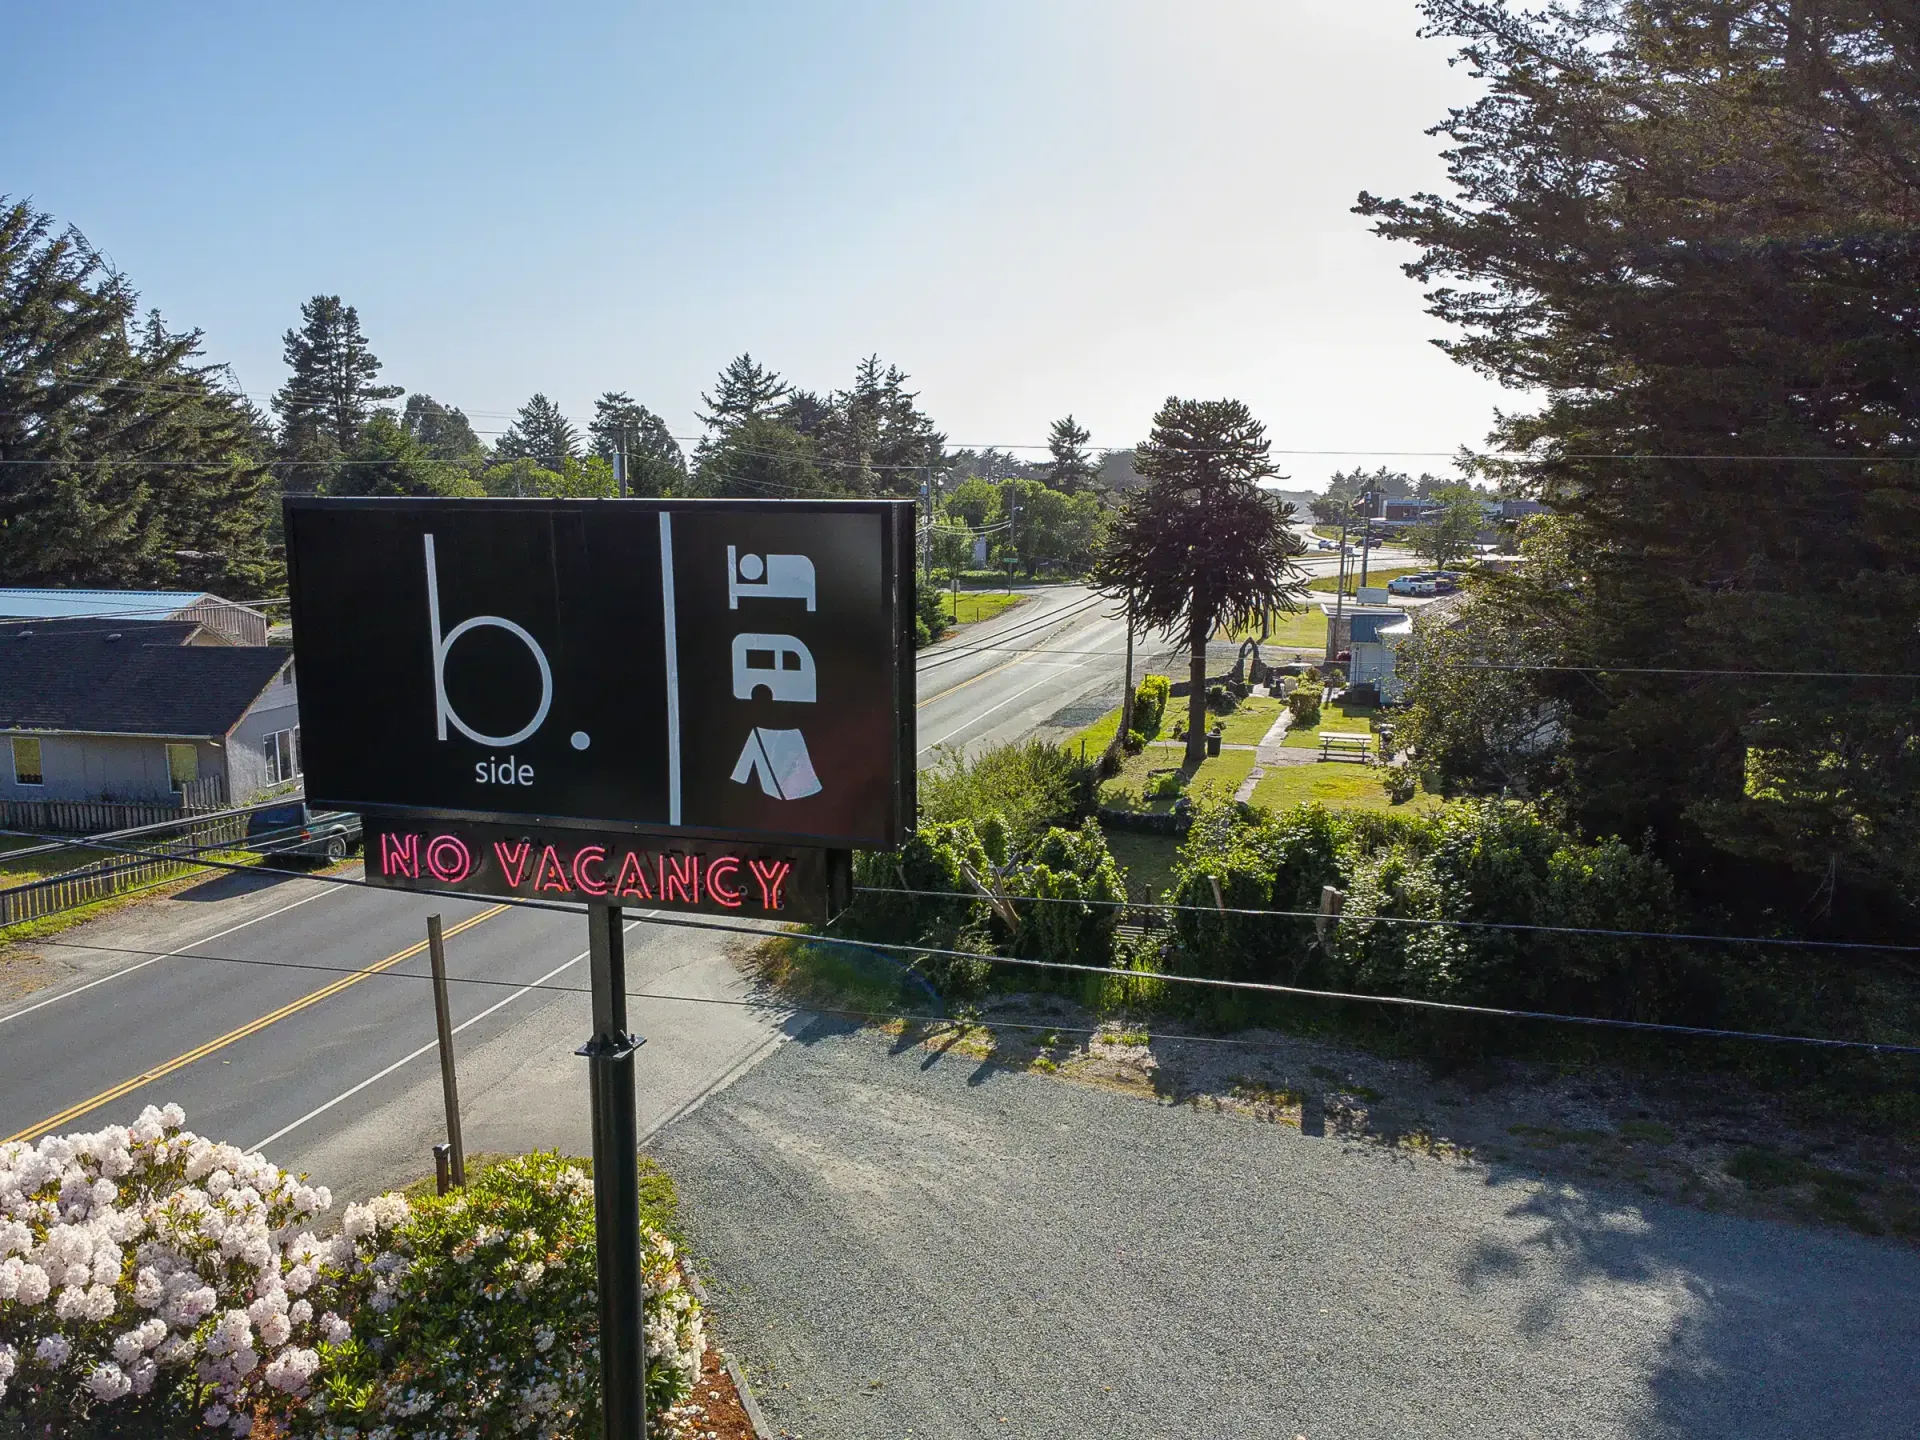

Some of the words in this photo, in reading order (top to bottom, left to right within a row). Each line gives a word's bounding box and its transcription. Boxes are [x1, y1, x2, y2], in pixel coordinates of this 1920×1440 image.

[475, 755, 534, 785] side
[381, 833, 471, 884] NO
[493, 841, 790, 910] VACANCY
